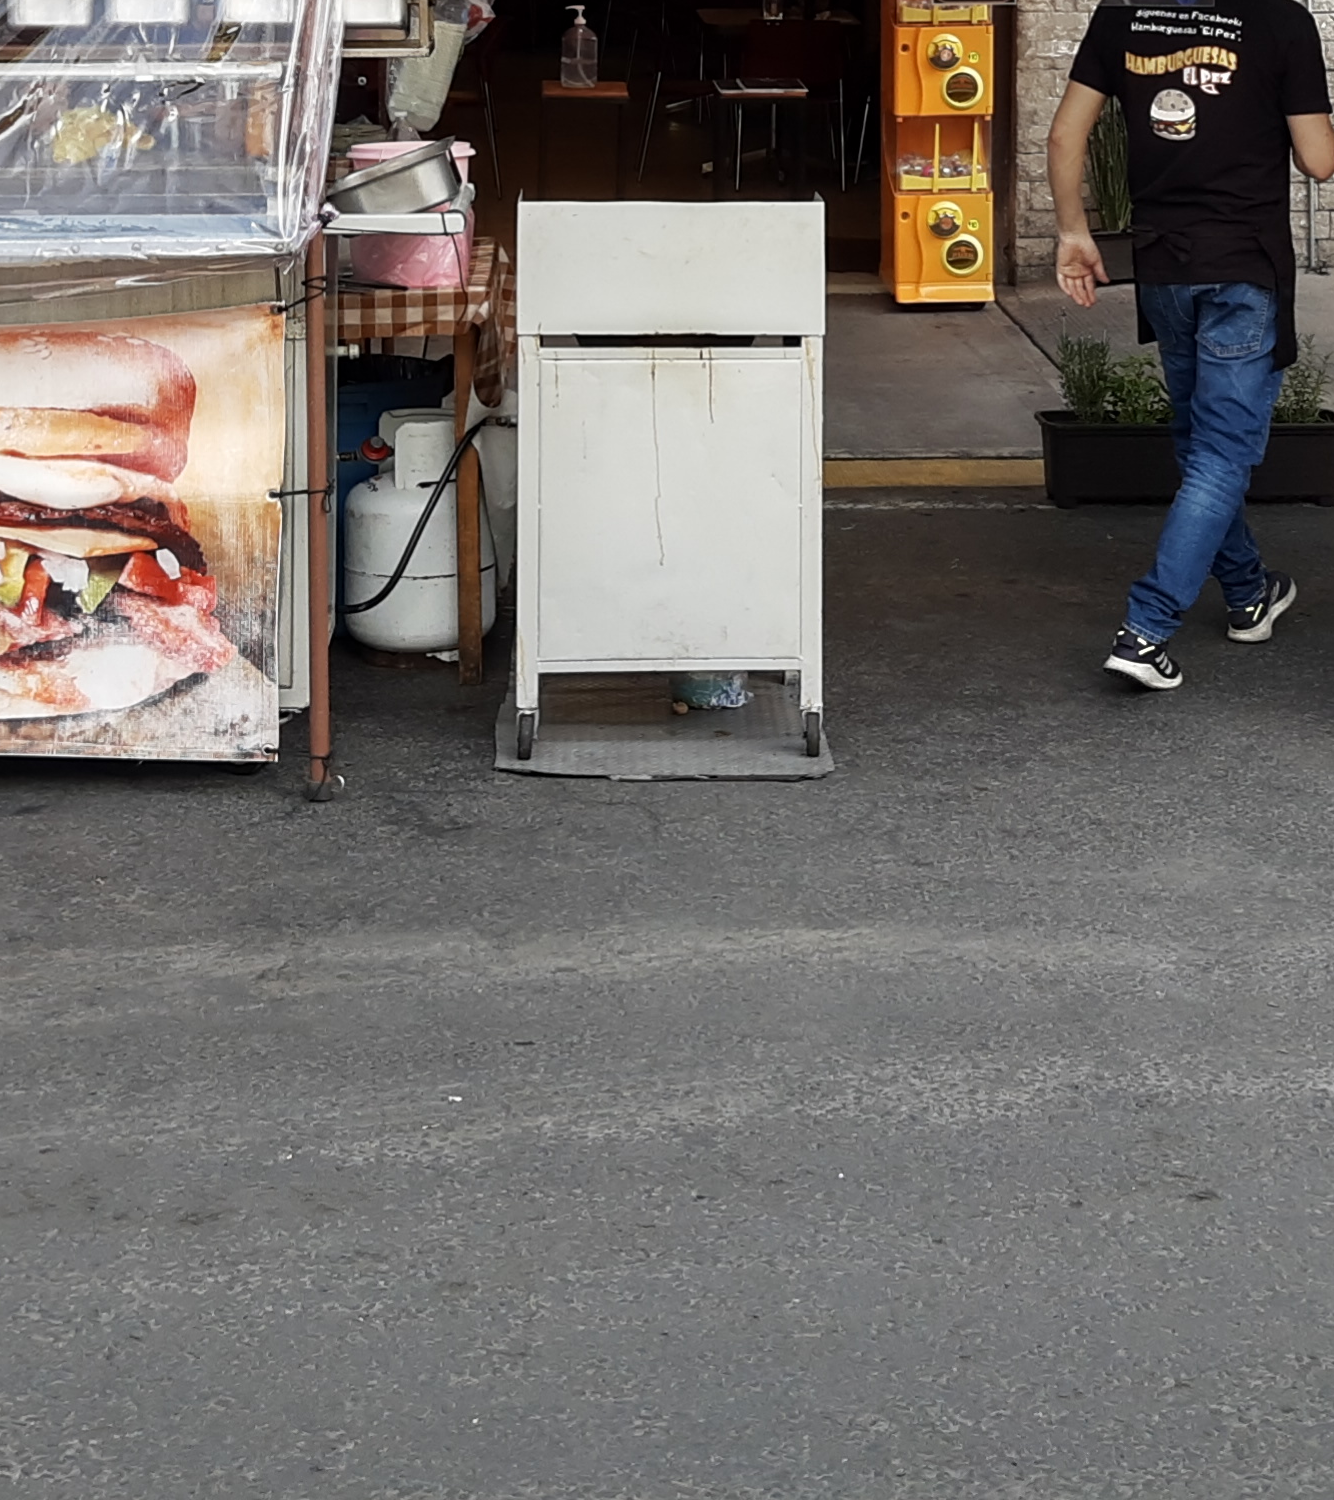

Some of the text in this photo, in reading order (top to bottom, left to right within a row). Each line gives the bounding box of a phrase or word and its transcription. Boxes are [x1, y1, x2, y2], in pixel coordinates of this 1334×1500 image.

[1125, 45, 1238, 76] HAMBURGUESAS
[1182, 65, 1232, 88] EL PEZ
